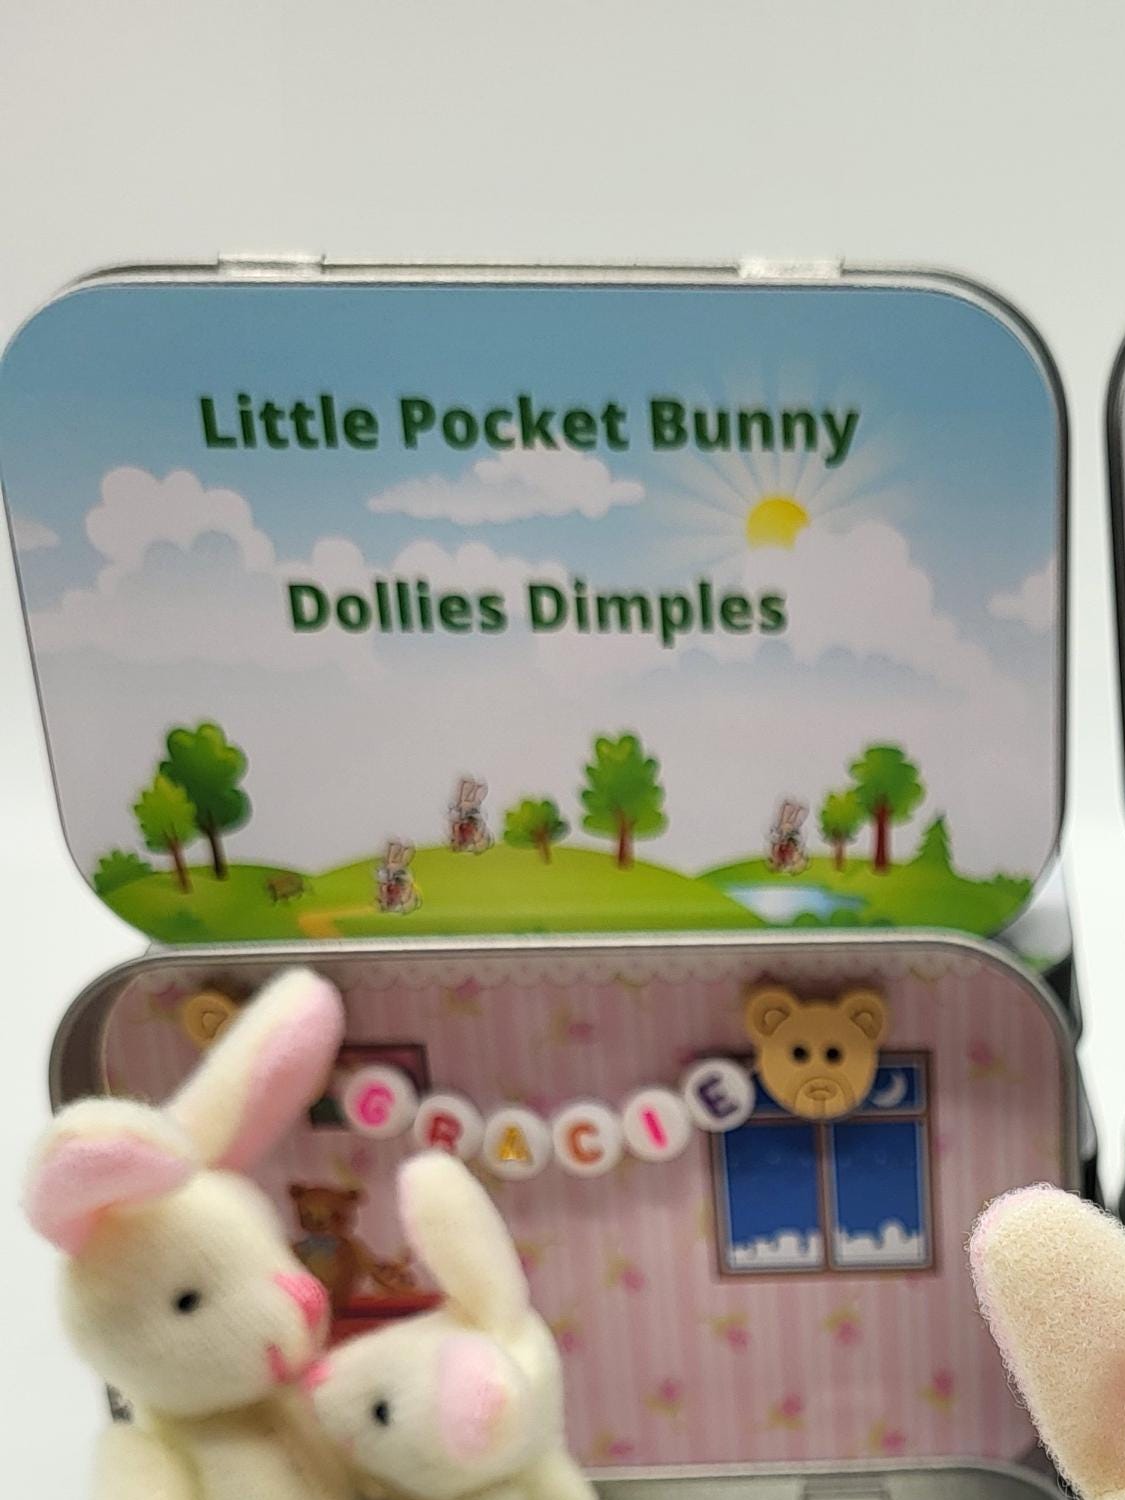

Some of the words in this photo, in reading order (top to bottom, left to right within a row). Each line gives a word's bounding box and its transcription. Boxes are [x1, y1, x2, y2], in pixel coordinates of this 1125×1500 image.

[200, 393, 380, 450] Little
[400, 395, 631, 451] Pocket
[650, 398, 860, 469] Bunny
[288, 579, 509, 634] Dollies
[528, 577, 788, 649] Dimples
[356, 1075, 739, 1166] GRACIE
